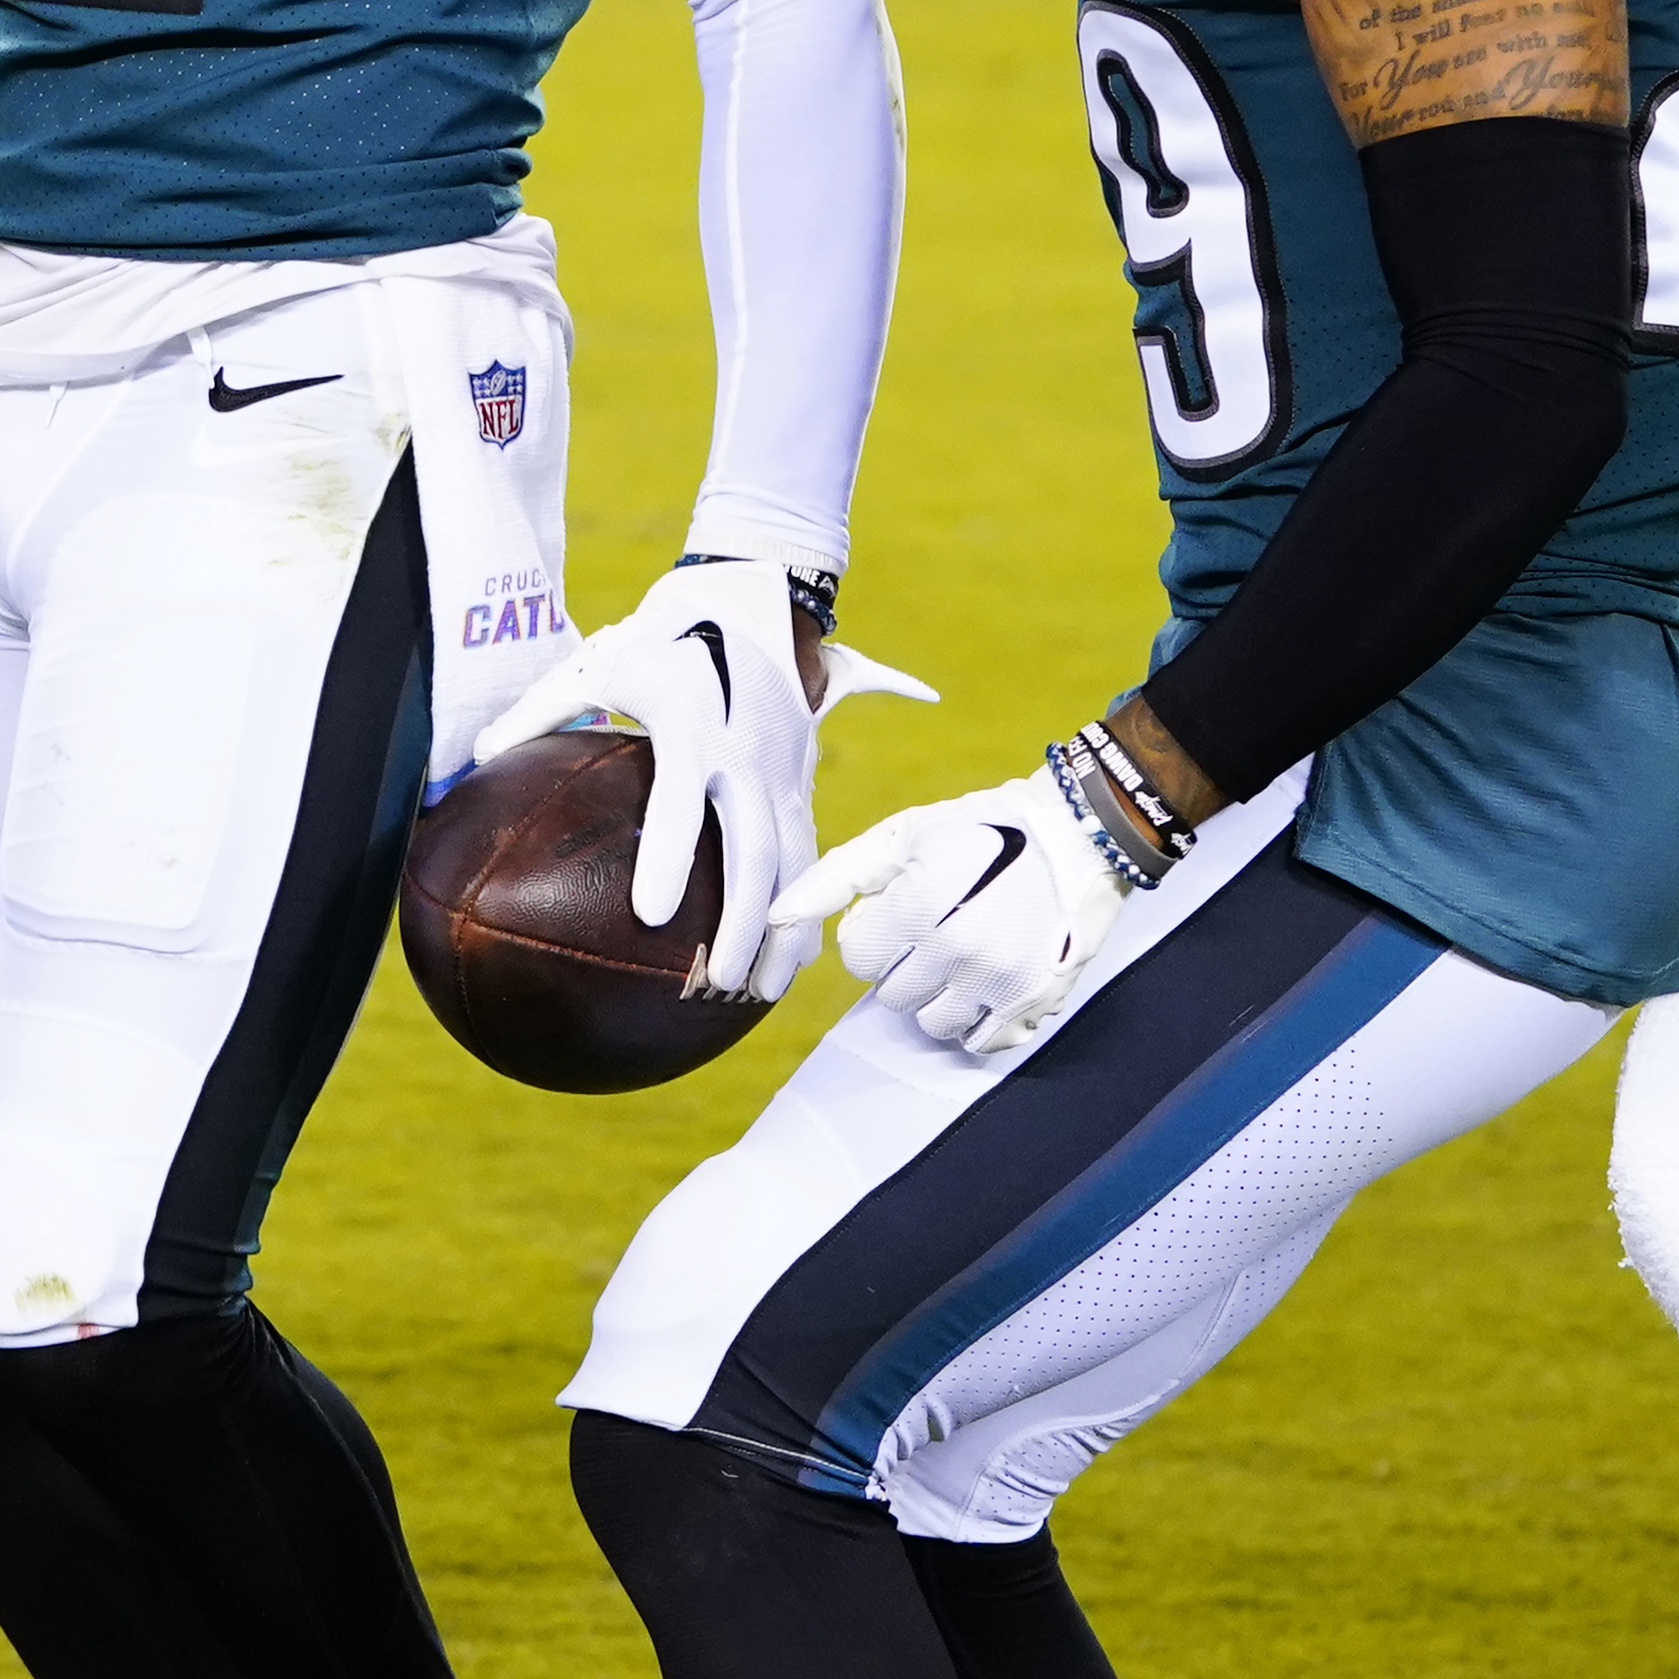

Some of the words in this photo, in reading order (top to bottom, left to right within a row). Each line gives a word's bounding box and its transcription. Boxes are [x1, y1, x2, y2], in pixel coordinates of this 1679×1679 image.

[478, 398, 519, 440] NFL
[485, 567, 547, 597] CRUC
[1072, 752, 1096, 779] NO
[1099, 744, 1144, 792] DAWG
